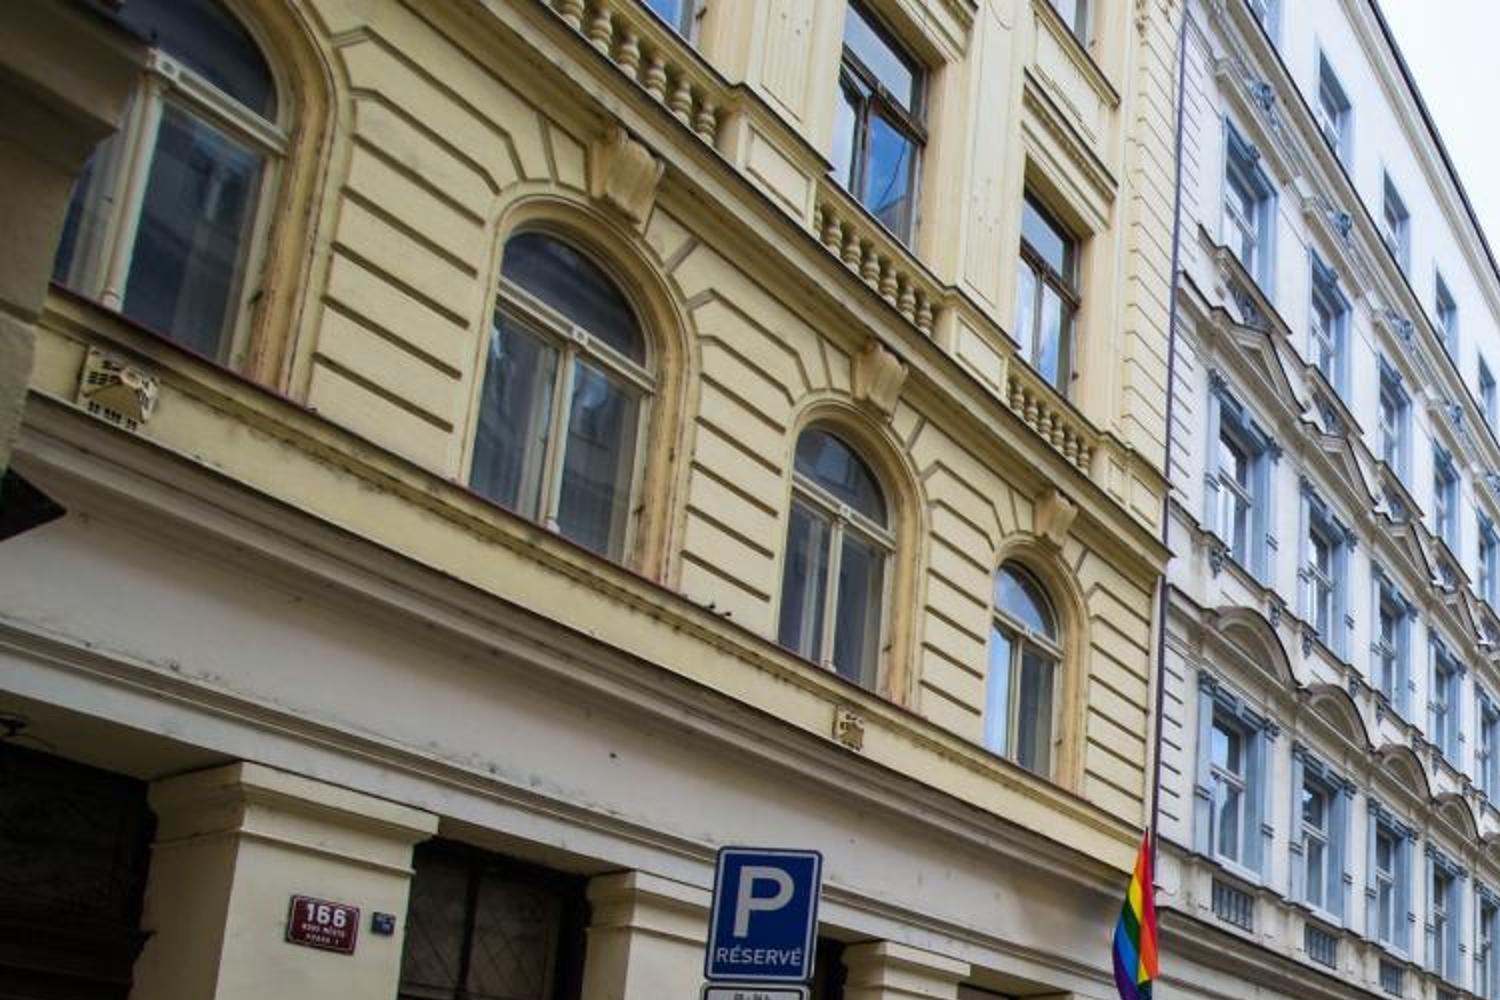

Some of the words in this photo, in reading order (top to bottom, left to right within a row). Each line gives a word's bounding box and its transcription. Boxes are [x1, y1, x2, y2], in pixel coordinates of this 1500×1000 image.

[733, 865, 795, 938] P
[307, 903, 346, 928] 166
[717, 944, 802, 967] RÉSERVÉ
